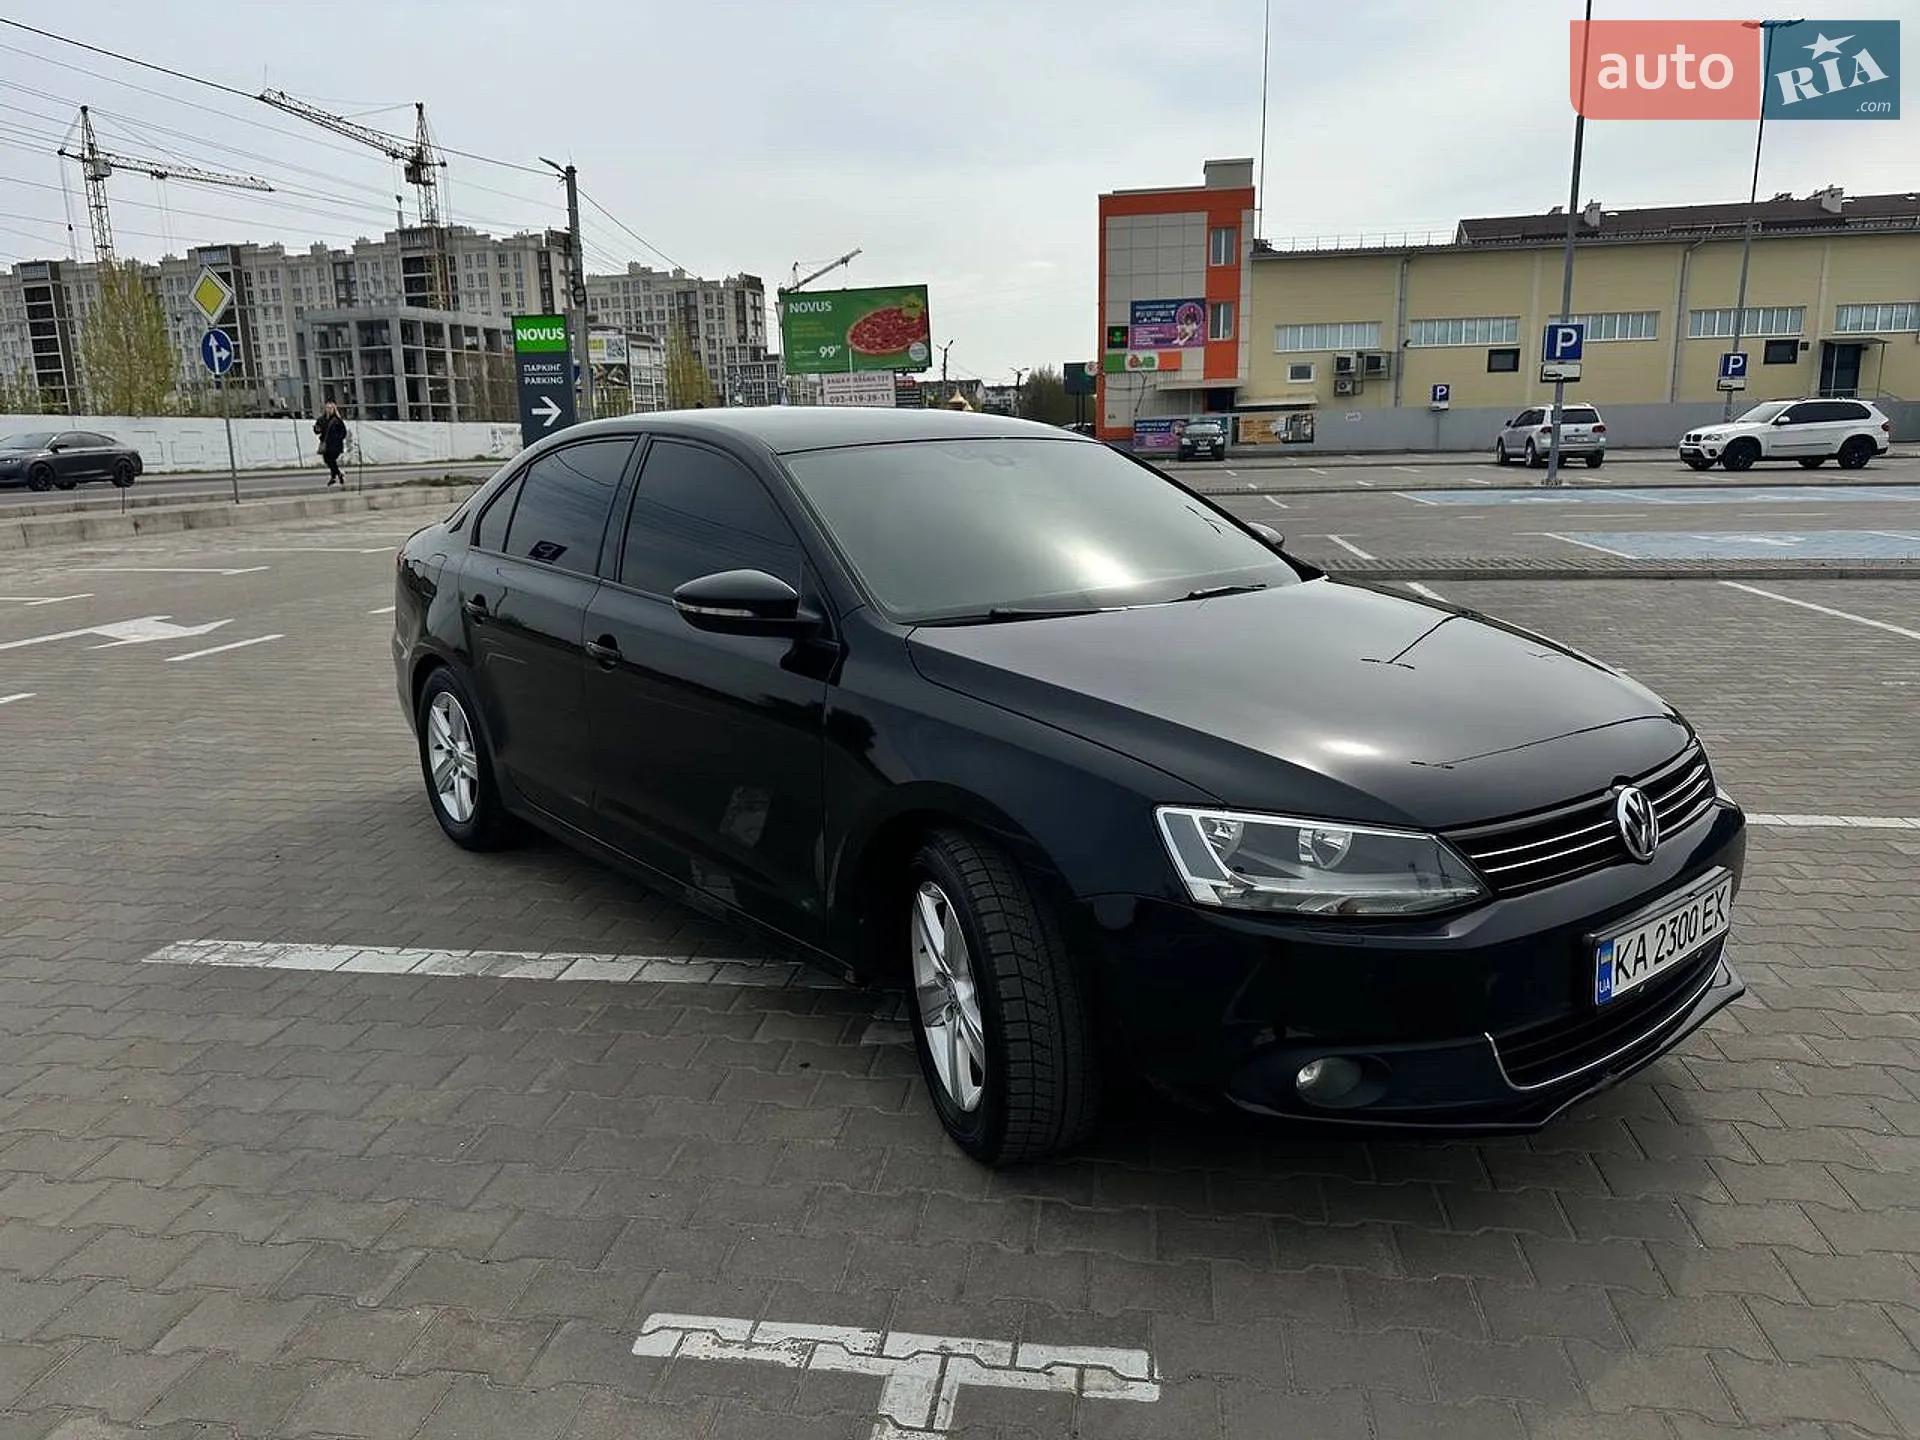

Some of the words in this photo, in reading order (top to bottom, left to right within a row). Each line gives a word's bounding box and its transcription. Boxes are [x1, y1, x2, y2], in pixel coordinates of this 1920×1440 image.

[788, 300, 833, 313] NOVUS
[516, 327, 565, 341] NOVUS
[1555, 327, 1578, 358] P
[523, 363, 562, 373] ПАРКІНГ
[1727, 355, 1743, 375] P
[524, 375, 564, 386] PARKING
[1436, 385, 1447, 400] P
[1615, 933, 1648, 985] KA
[1654, 904, 1699, 963] 2300
[1702, 886, 1728, 937] EX
[1599, 978, 1611, 993] UA
